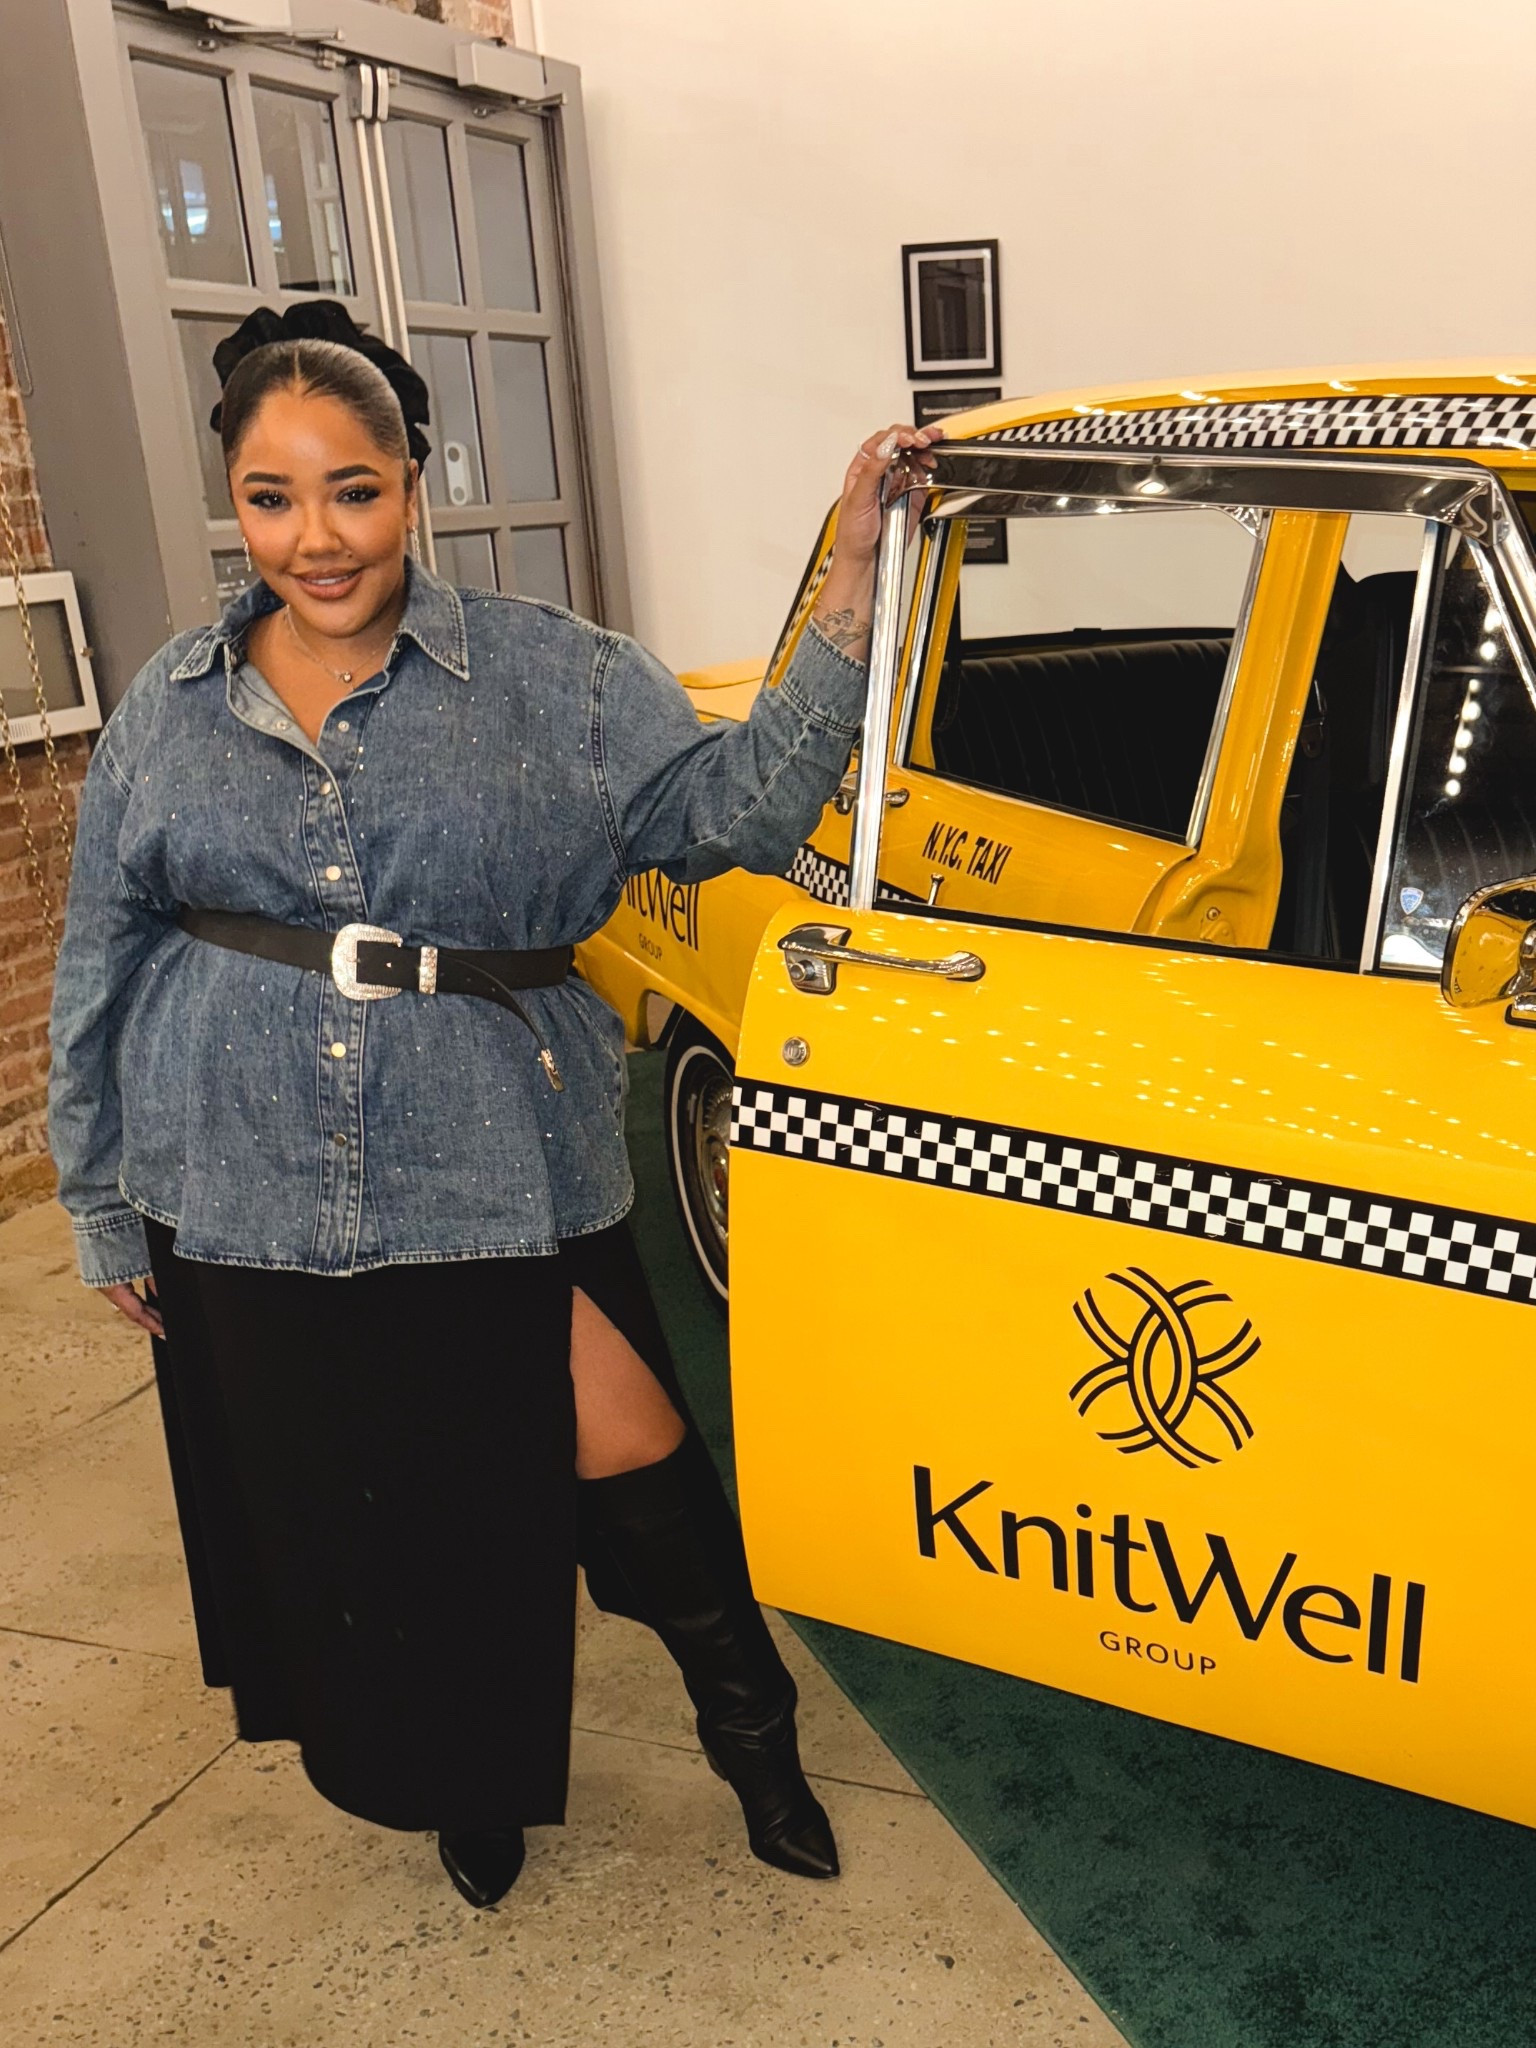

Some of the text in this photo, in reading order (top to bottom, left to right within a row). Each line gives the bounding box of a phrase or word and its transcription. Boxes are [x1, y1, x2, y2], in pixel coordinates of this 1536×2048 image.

[922, 821, 1012, 885] N.Y.C. TAXI
[638, 932, 663, 960] GROUP
[913, 1464, 1426, 1683] KnitWell
[1099, 1631, 1217, 1675] GROUP
